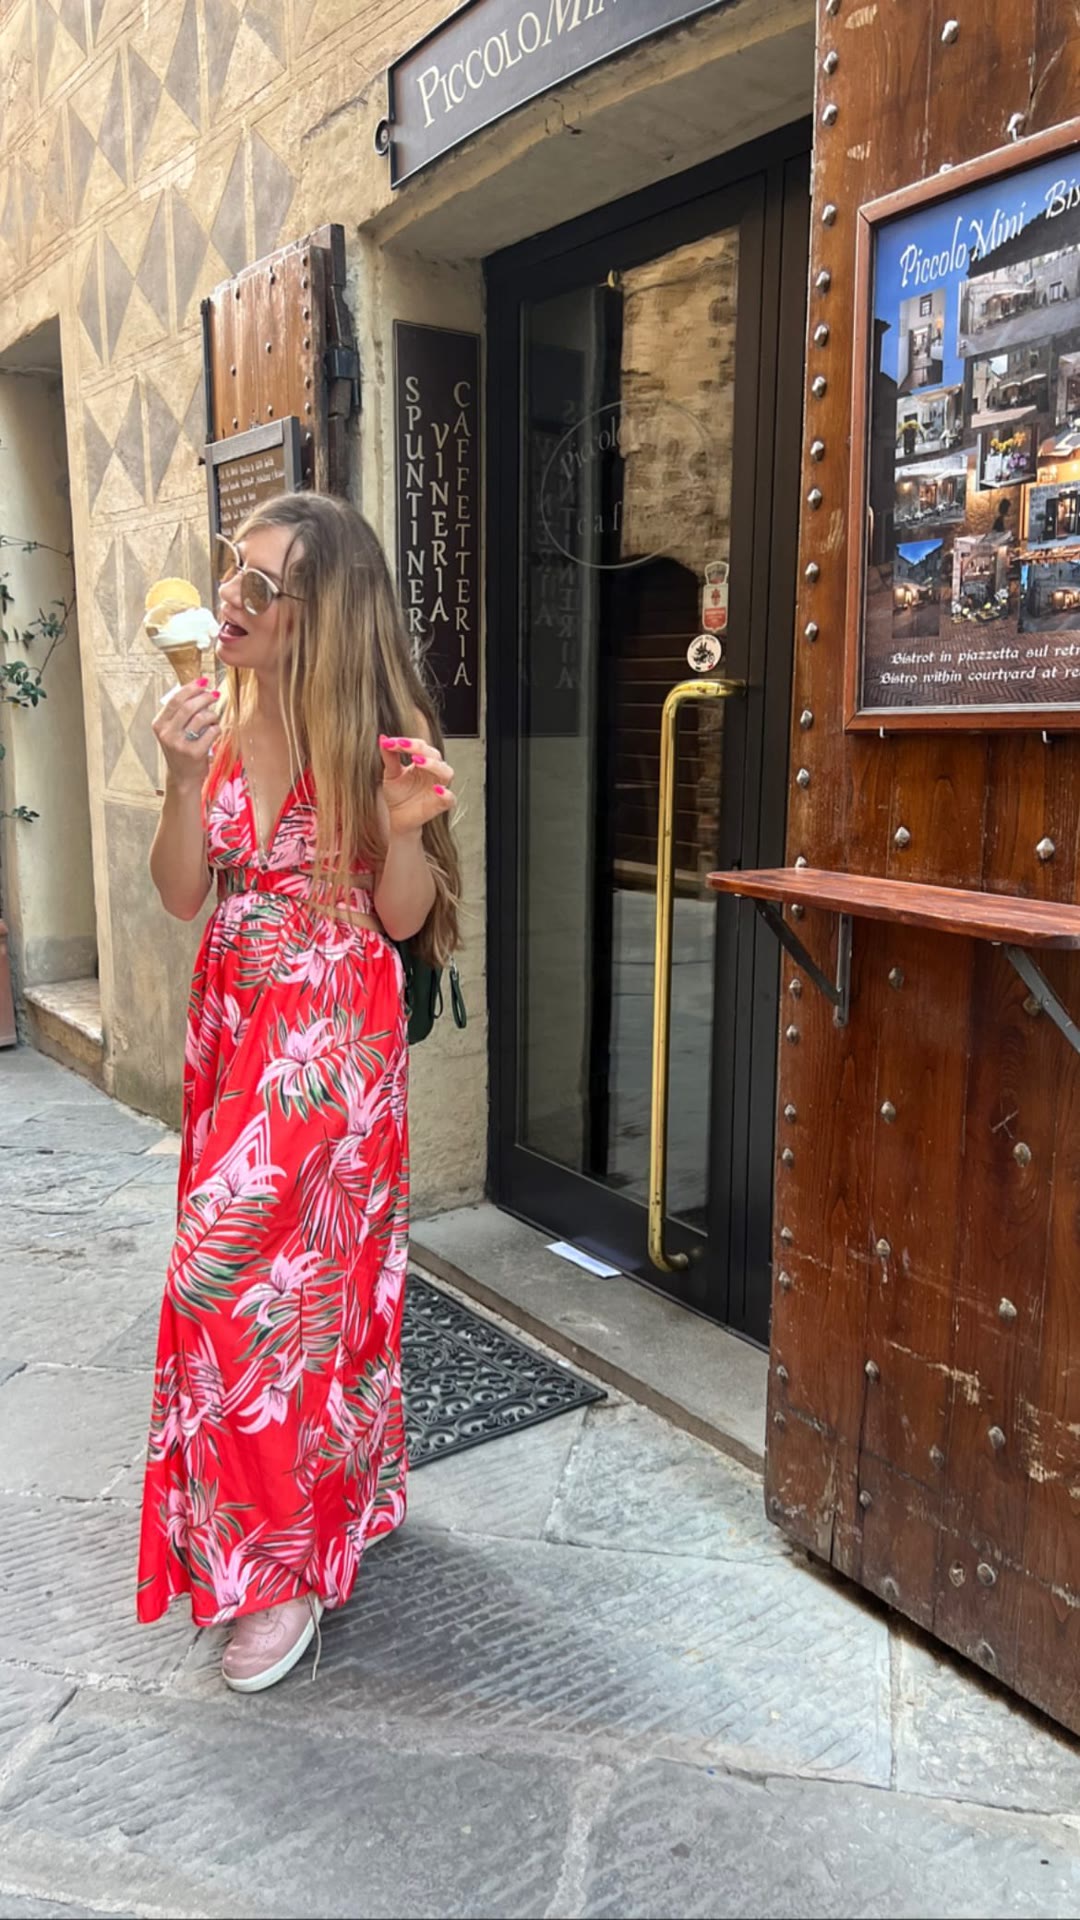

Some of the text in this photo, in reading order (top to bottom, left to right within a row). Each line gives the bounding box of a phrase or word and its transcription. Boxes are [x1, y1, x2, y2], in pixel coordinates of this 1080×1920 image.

[900, 216, 967, 288] Piccolo
[970, 202, 1026, 261] Mini
[429, 422, 449, 622] VINERIA
[453, 381, 472, 686] CAFFETTERIA
[880, 672, 918, 685] Bistro
[922, 670, 962, 684] within
[968, 666, 1036, 683] courtyard
[1042, 666, 1057, 678] at
[891, 651, 934, 664] Bistrot
[940, 650, 952, 663] in
[957, 647, 1019, 667] piazzetta
[1026, 644, 1048, 658] sul
